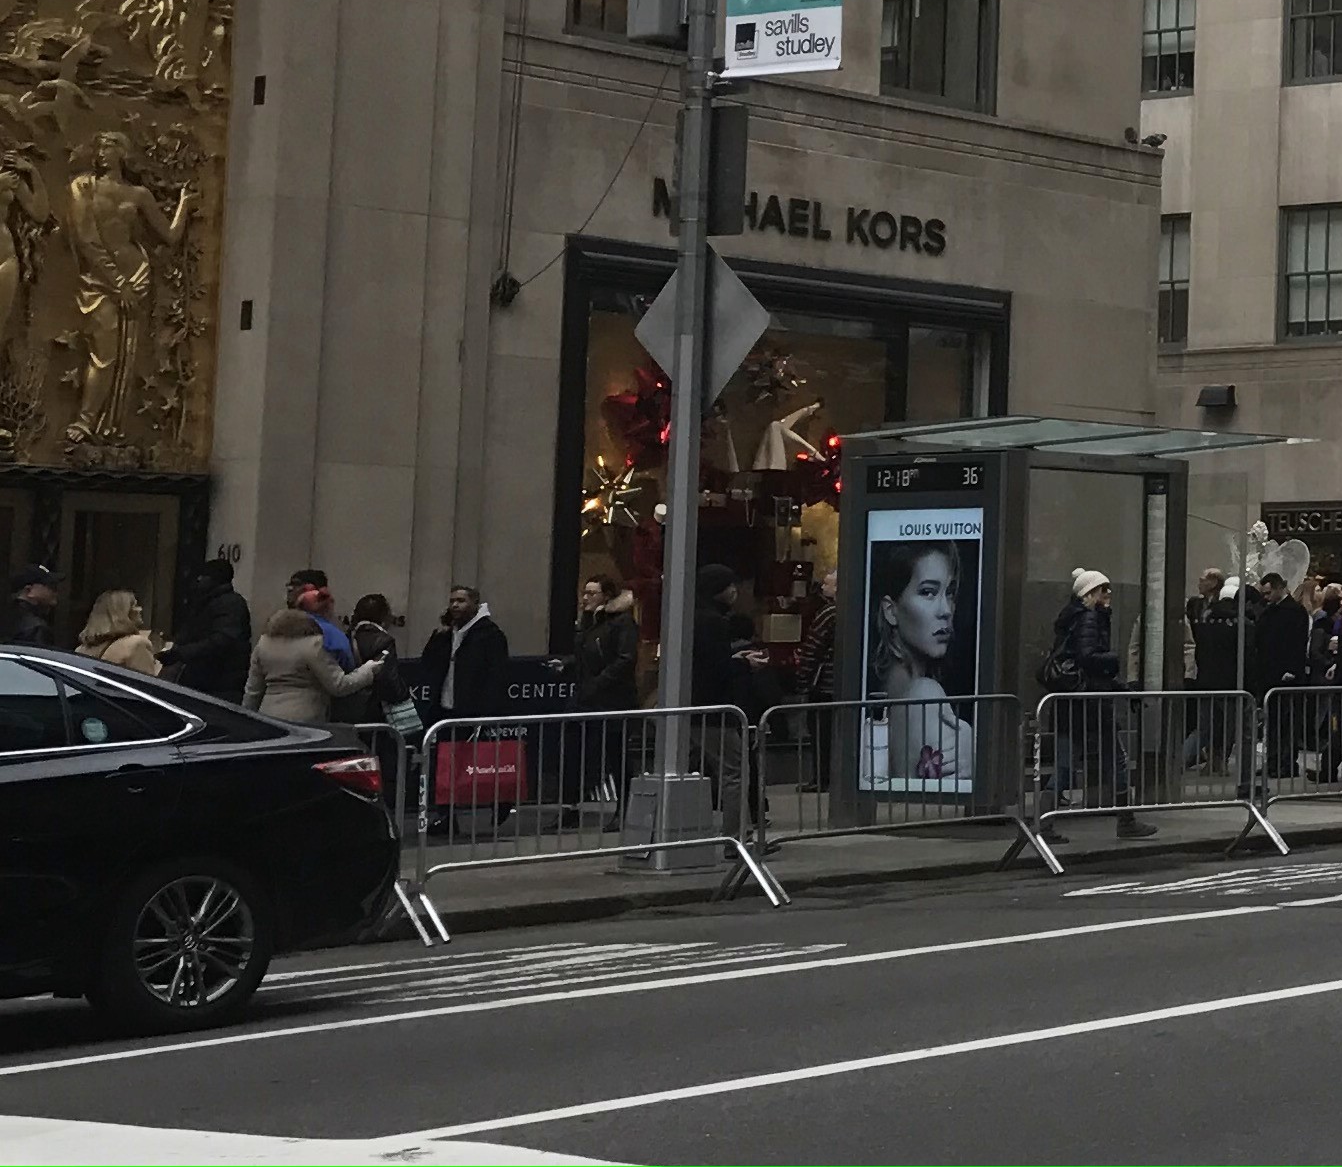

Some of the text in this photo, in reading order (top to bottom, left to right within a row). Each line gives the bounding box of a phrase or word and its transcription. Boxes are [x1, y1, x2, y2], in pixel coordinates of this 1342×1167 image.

[764, 13, 809, 37] savills
[776, 33, 836, 57] studley
[653, 176, 946, 257] MHAEL KORS
[899, 522, 981, 536] LOUIS VUITTON
[218, 543, 241, 563] 610
